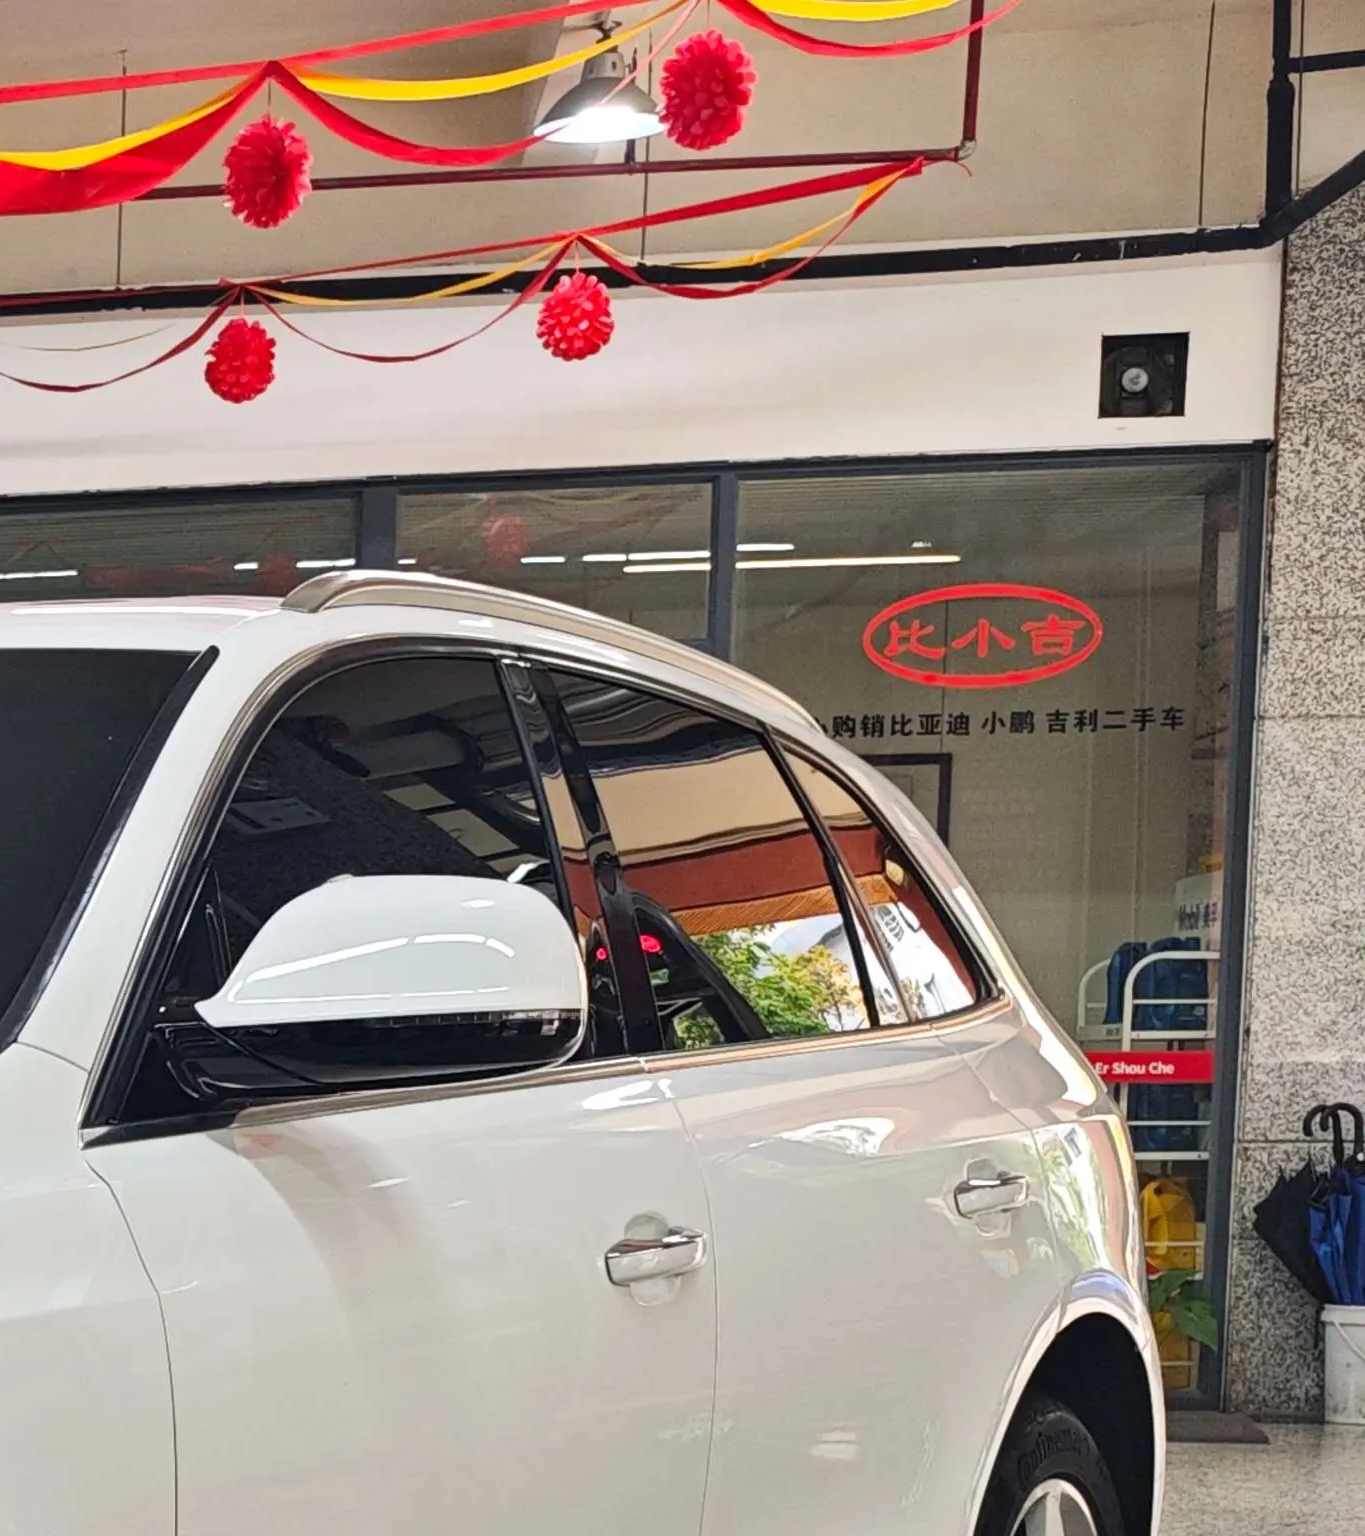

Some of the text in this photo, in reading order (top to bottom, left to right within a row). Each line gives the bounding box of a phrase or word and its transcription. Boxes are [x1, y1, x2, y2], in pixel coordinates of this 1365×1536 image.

[884, 614, 1085, 660] 比小吉
[816, 706, 1185, 739] 购销比亚迪 小鹏 吉利二手车
[1111, 1060, 1147, 1075] Shou
[1148, 1060, 1176, 1075] Che
